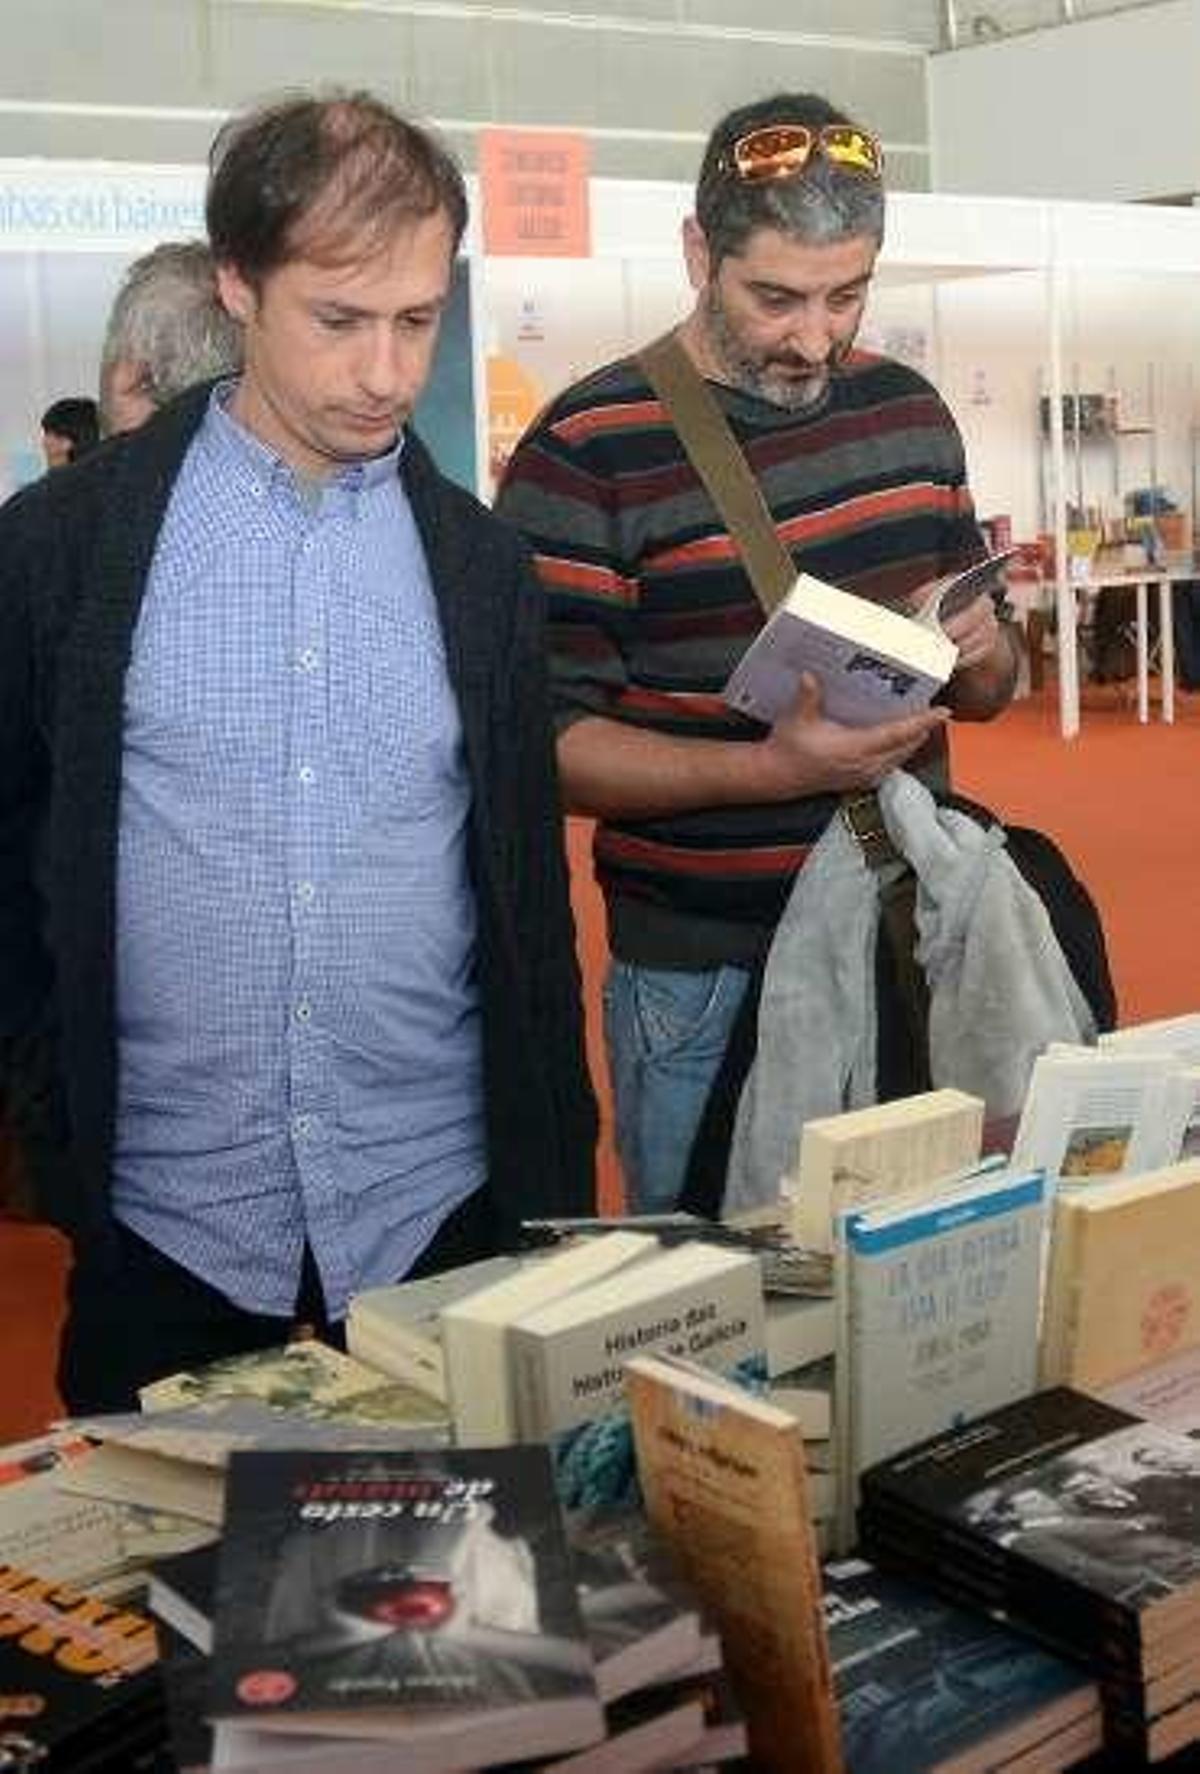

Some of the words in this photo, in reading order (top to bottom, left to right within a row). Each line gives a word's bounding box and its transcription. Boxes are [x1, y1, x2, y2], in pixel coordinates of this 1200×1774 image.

[604, 1317, 681, 1354] Historia
[572, 1367, 623, 1397] histo
[300, 1501, 403, 1523] cesto
